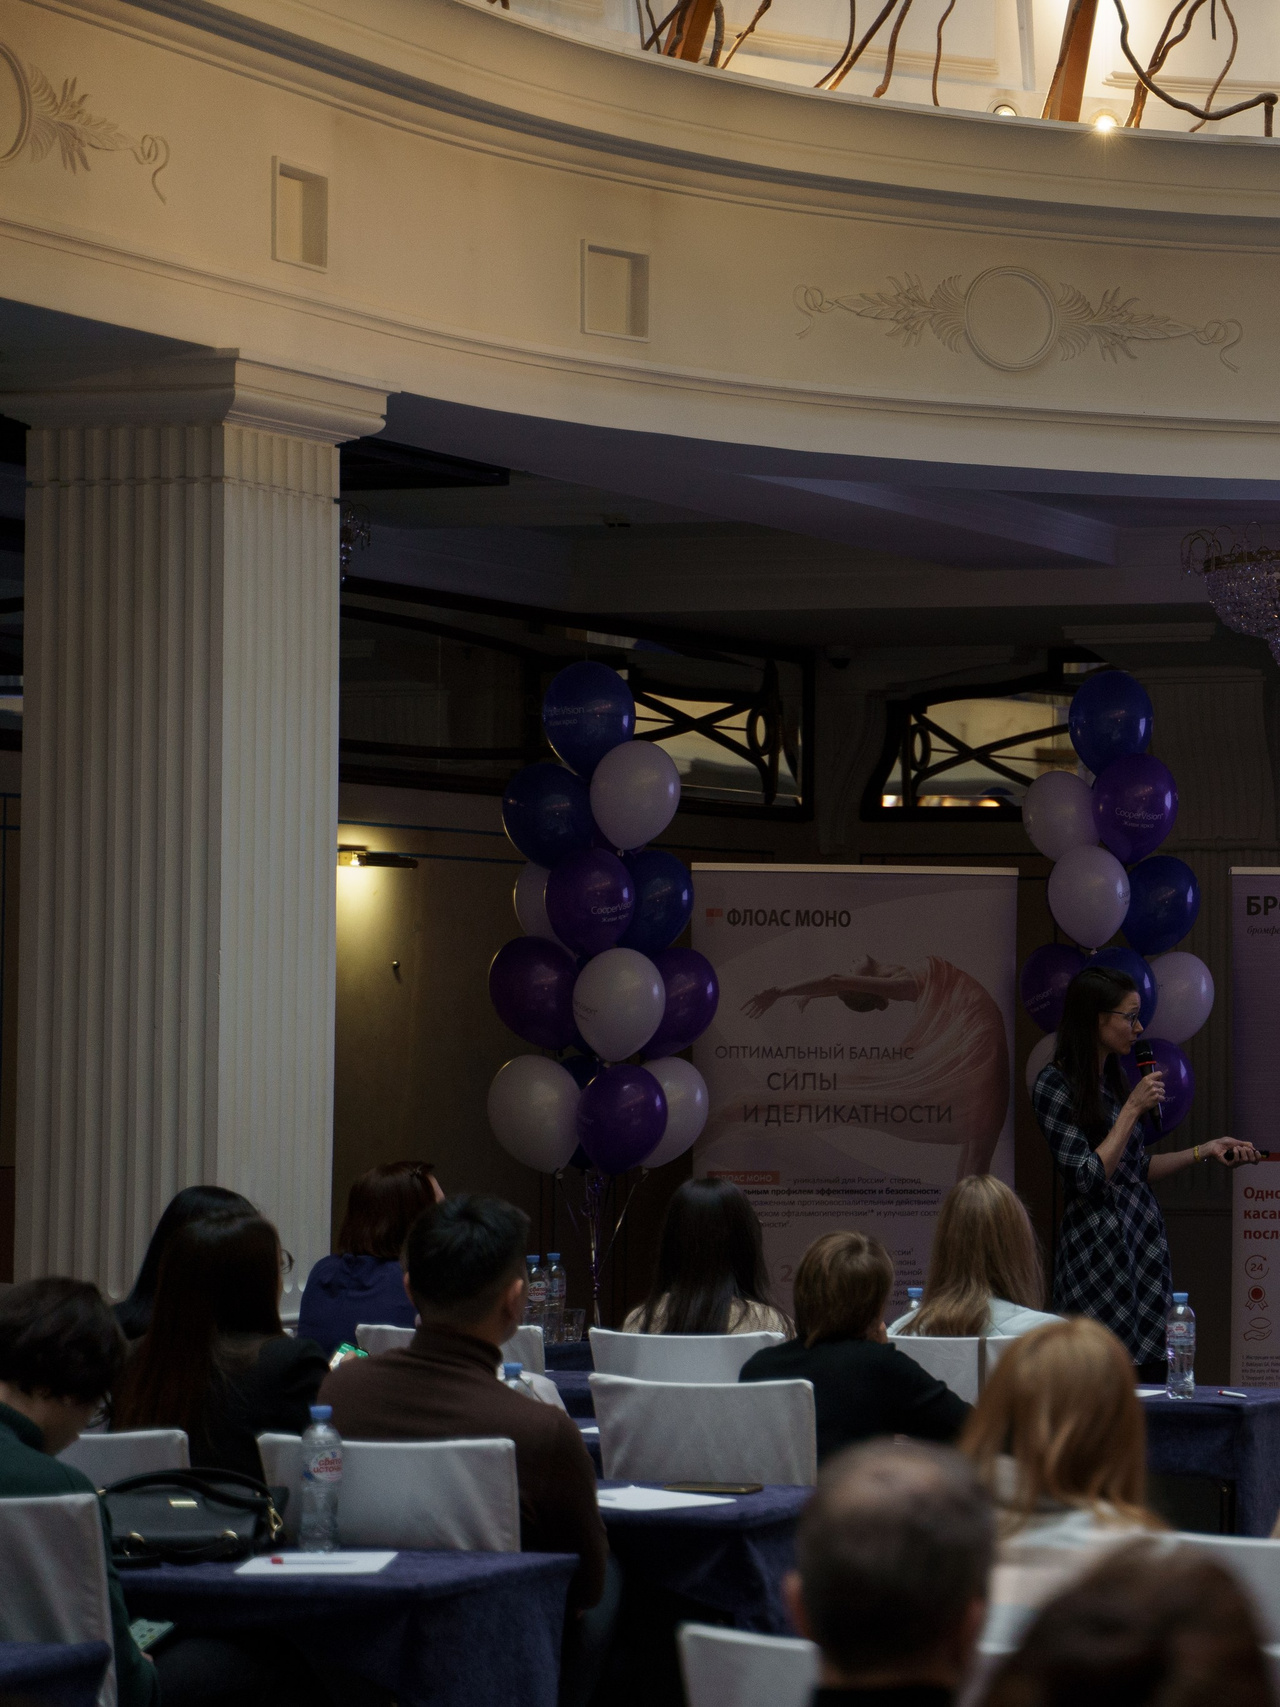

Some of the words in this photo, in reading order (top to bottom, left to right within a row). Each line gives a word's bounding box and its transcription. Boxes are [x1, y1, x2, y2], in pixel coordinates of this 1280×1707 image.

[727, 908, 791, 927] ФЛОАС
[795, 910, 852, 928] МОНО
[715, 1043, 844, 1060] ОПТИМАЛЬНЫЙ
[849, 1046, 915, 1060] БАЛАНС
[767, 1072, 838, 1090] СИЛЫ
[744, 1104, 758, 1123] И
[765, 1105, 952, 1126] ДЕЛИКАТНОСТИ
[746, 1174, 772, 1182] МОНО
[815, 1188, 876, 1196] эффективности
